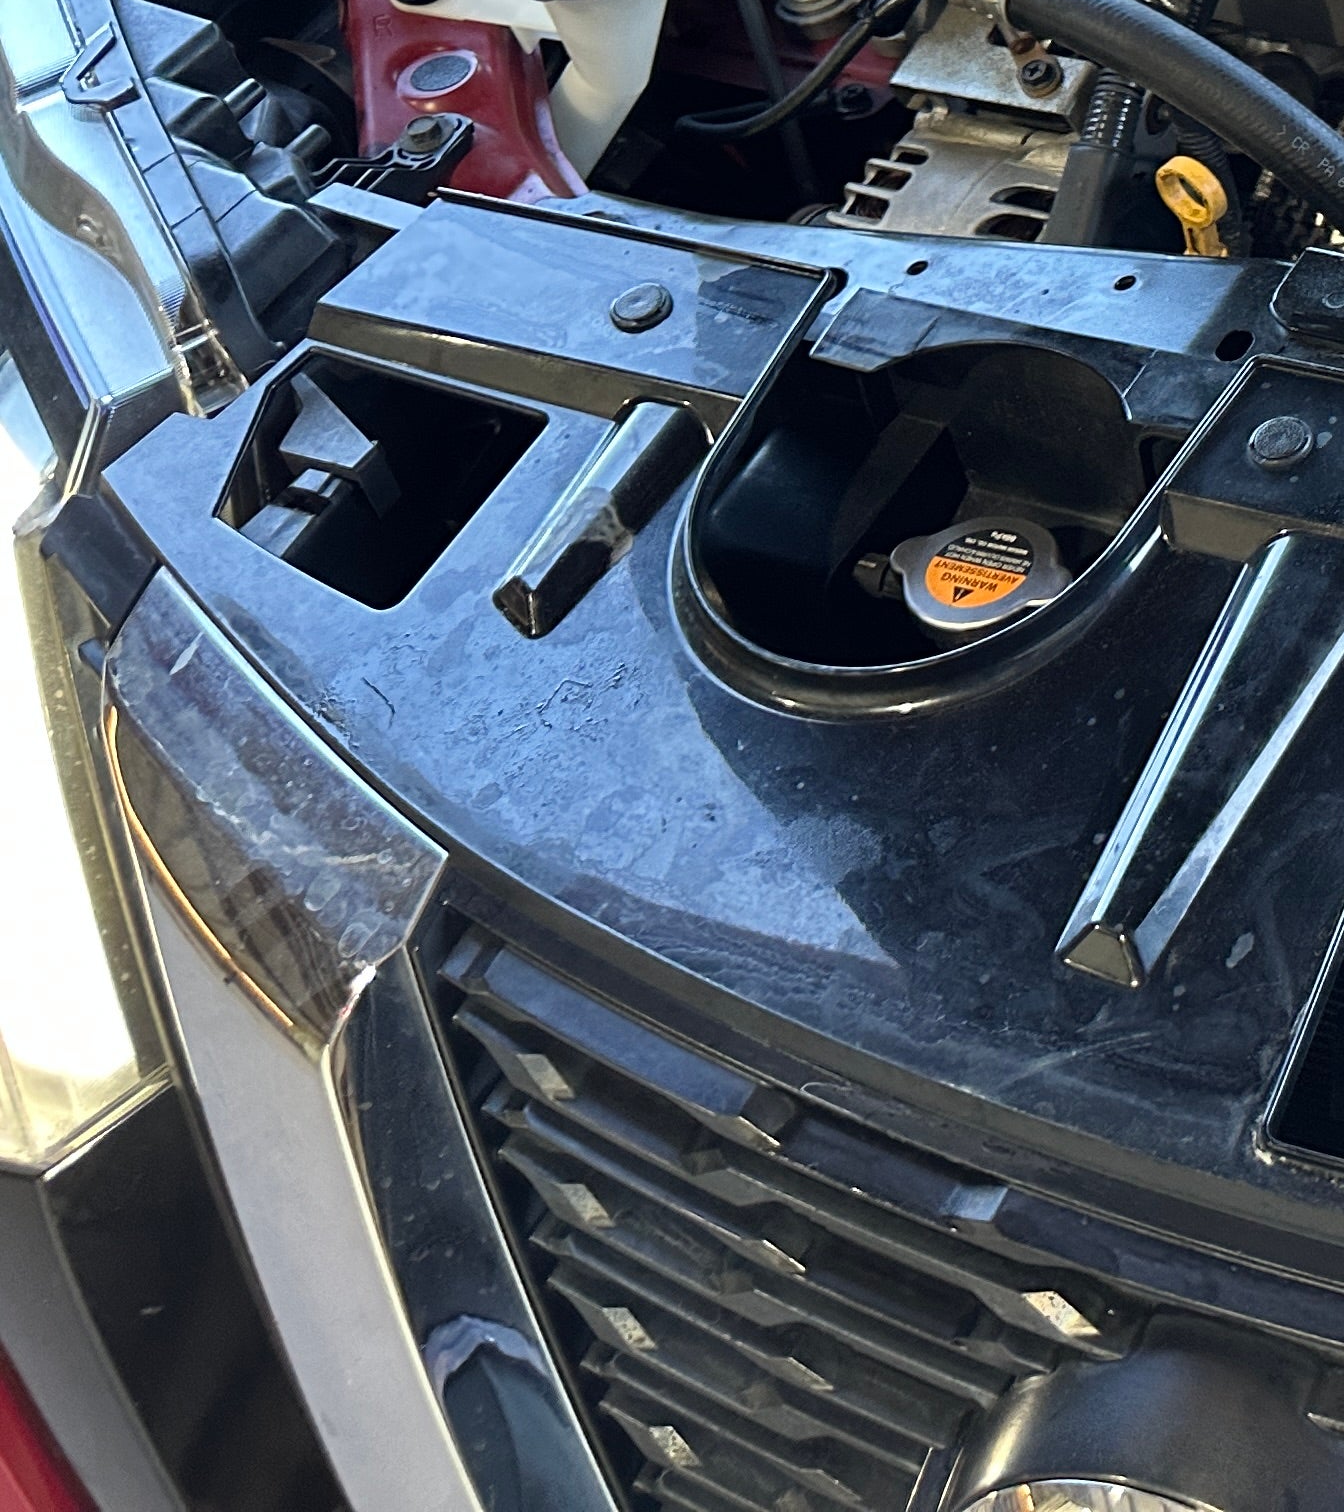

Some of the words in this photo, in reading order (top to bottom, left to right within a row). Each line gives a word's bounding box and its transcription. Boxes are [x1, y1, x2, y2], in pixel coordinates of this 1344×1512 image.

[1317, 157, 1336, 179] PA
[934, 559, 1021, 585] AVERTISSEMENT
[941, 571, 998, 593] WARNING
